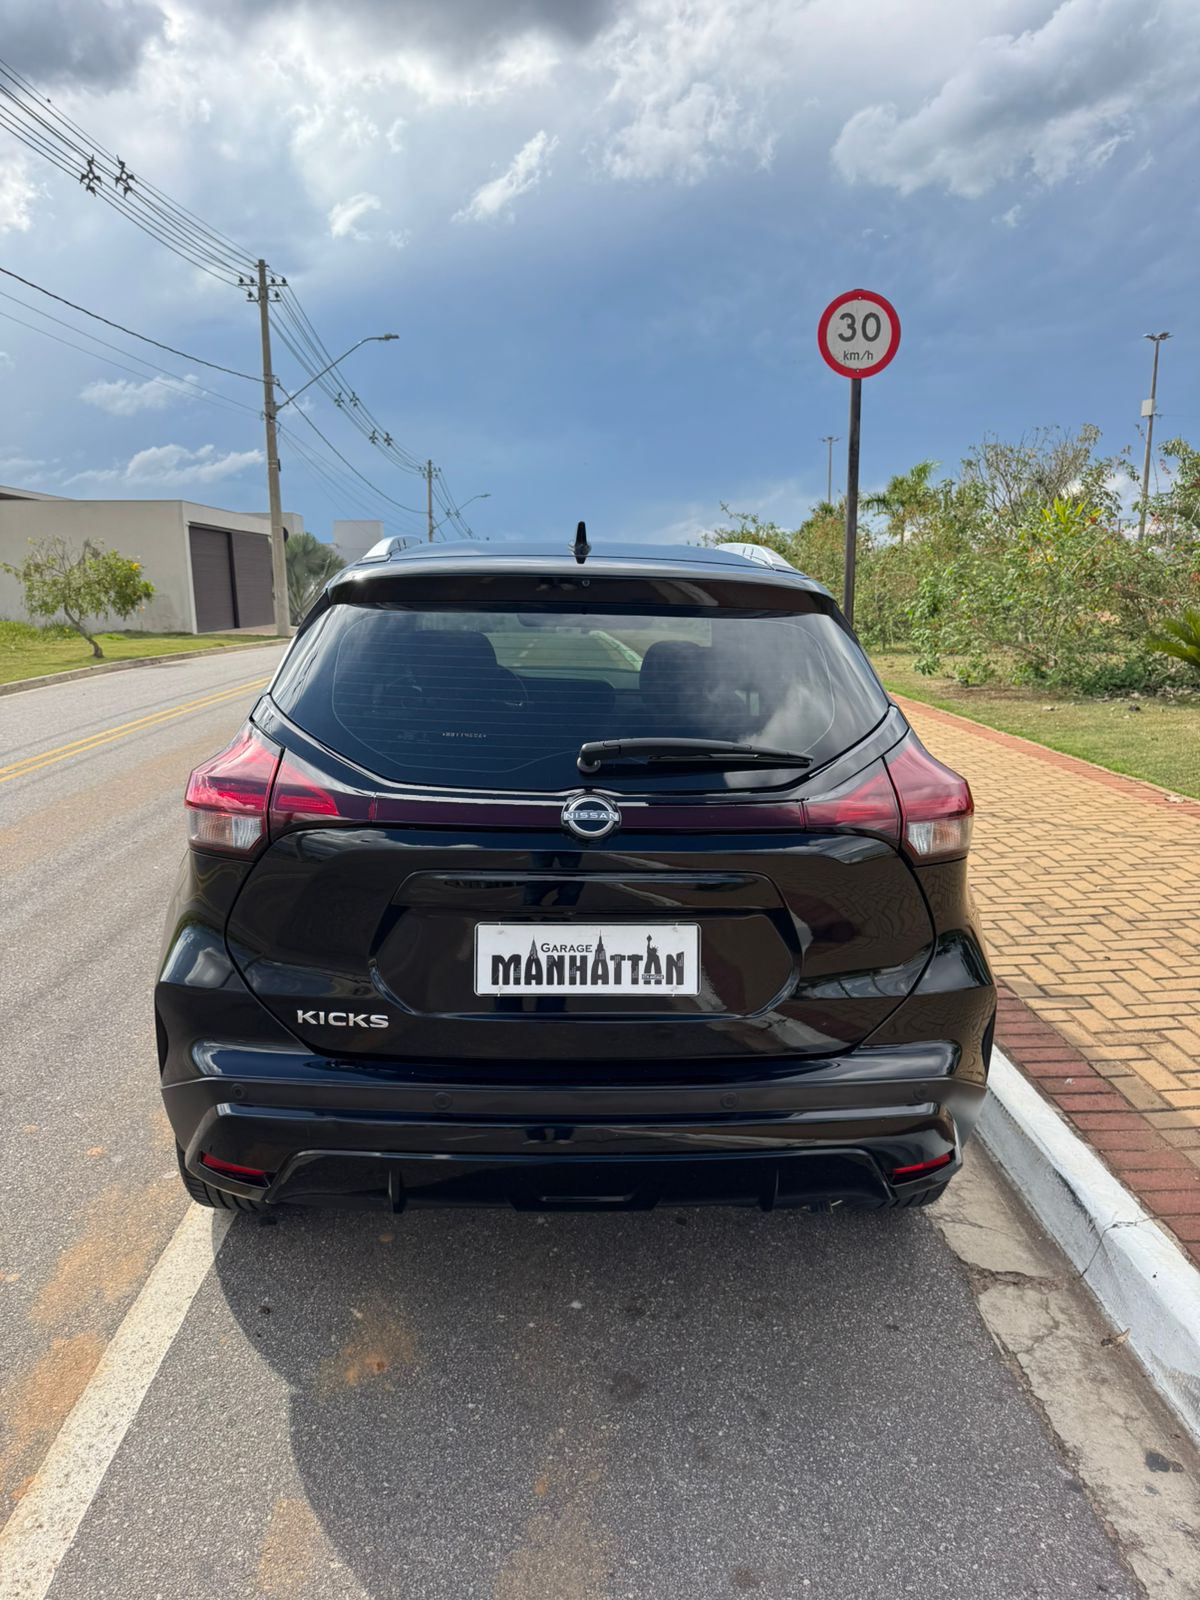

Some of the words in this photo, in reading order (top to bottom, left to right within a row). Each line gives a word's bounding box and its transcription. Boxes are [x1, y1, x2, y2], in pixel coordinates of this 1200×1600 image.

[838, 312, 881, 342] 30
[843, 350, 874, 361] km/h
[565, 812, 618, 820] NISSAN
[540, 942, 593, 953] GARAGE
[491, 948, 685, 986] MANHATTAN
[297, 1010, 389, 1028] KICKS
